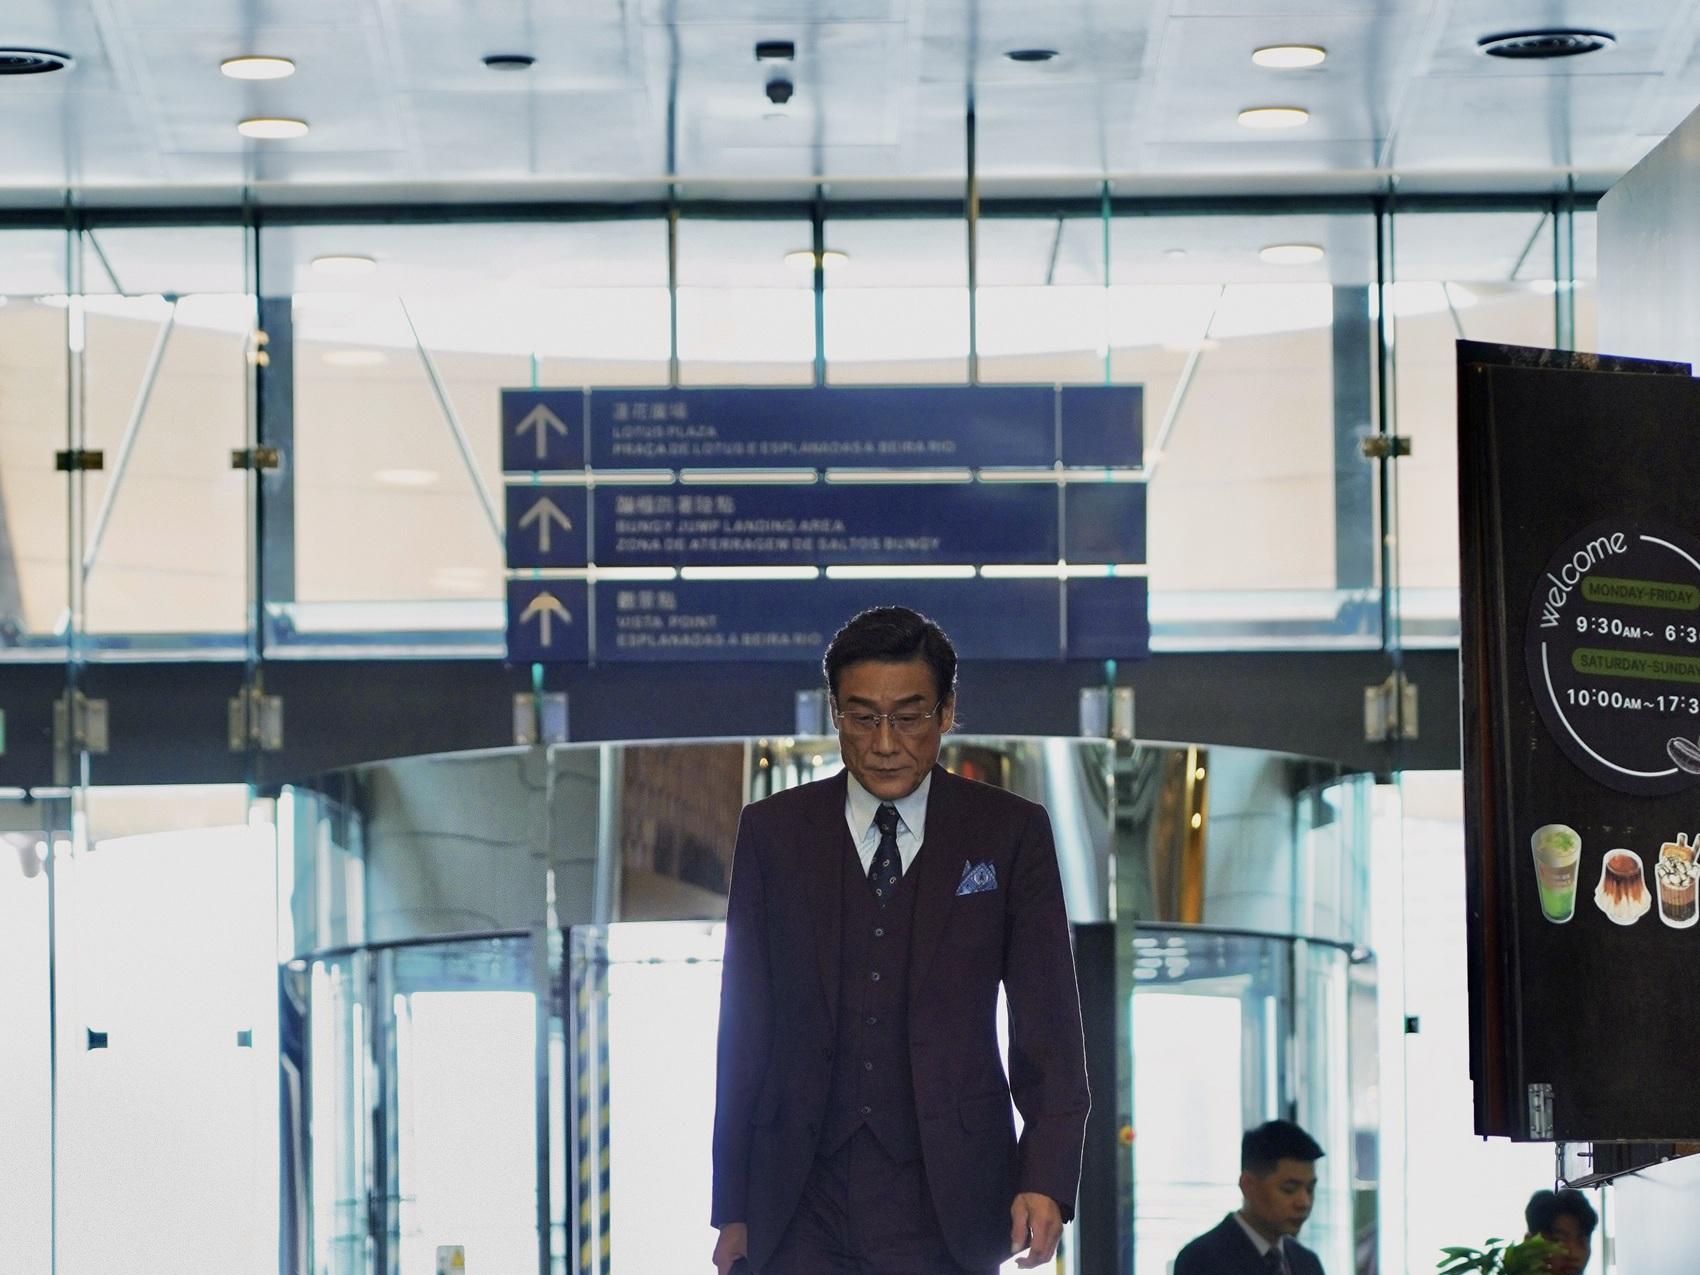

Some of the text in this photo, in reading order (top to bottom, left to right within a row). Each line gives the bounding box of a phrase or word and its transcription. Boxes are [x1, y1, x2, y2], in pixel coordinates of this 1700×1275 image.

[612, 425, 717, 438] LOTUS PLAZA
[678, 520, 721, 532] JUMP
[723, 519, 796, 532] LANDING
[798, 519, 846, 532] AREA
[616, 538, 662, 551] ZONA
[664, 538, 686, 551] DE
[1540, 532, 1627, 628] welcome
[1589, 583, 1693, 604] MONDAY-FRIDAY
[616, 615, 718, 628] VISTA POINT
[1665, 625, 1700, 643] 6:3
